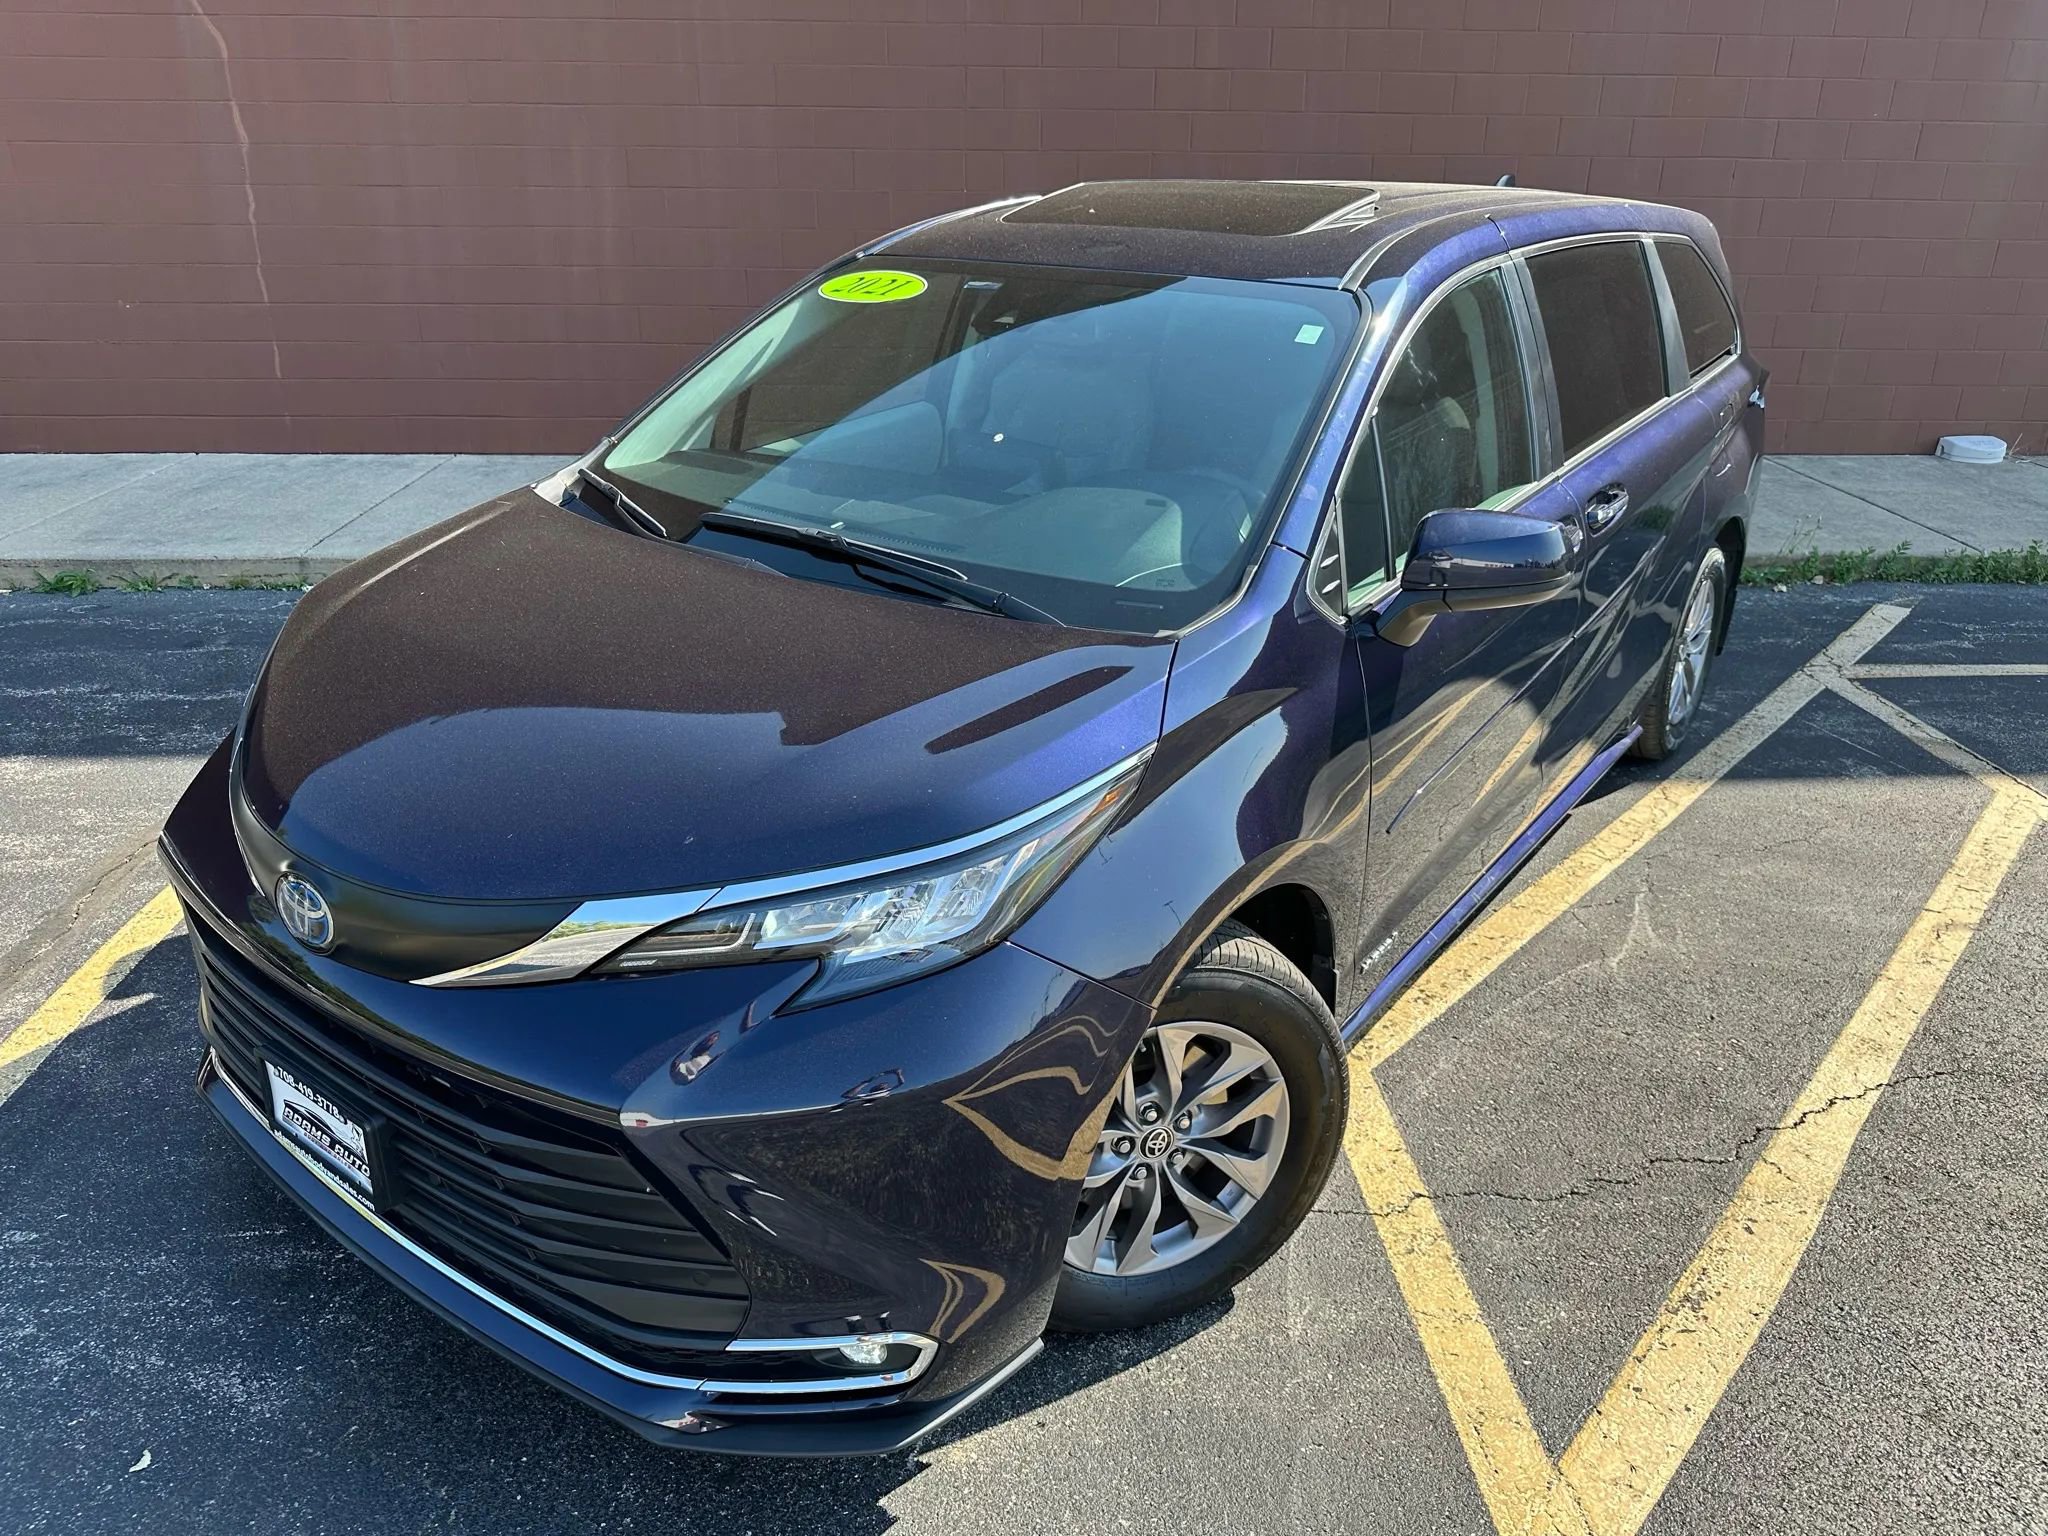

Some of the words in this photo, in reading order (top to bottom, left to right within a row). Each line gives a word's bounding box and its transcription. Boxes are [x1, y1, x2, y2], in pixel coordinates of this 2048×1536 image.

[829, 276, 913, 297] 2021
[277, 1065, 340, 1121] 708-419-3778
[283, 1106, 331, 1146] ADAMS
[334, 1143, 371, 1177] AUTO
